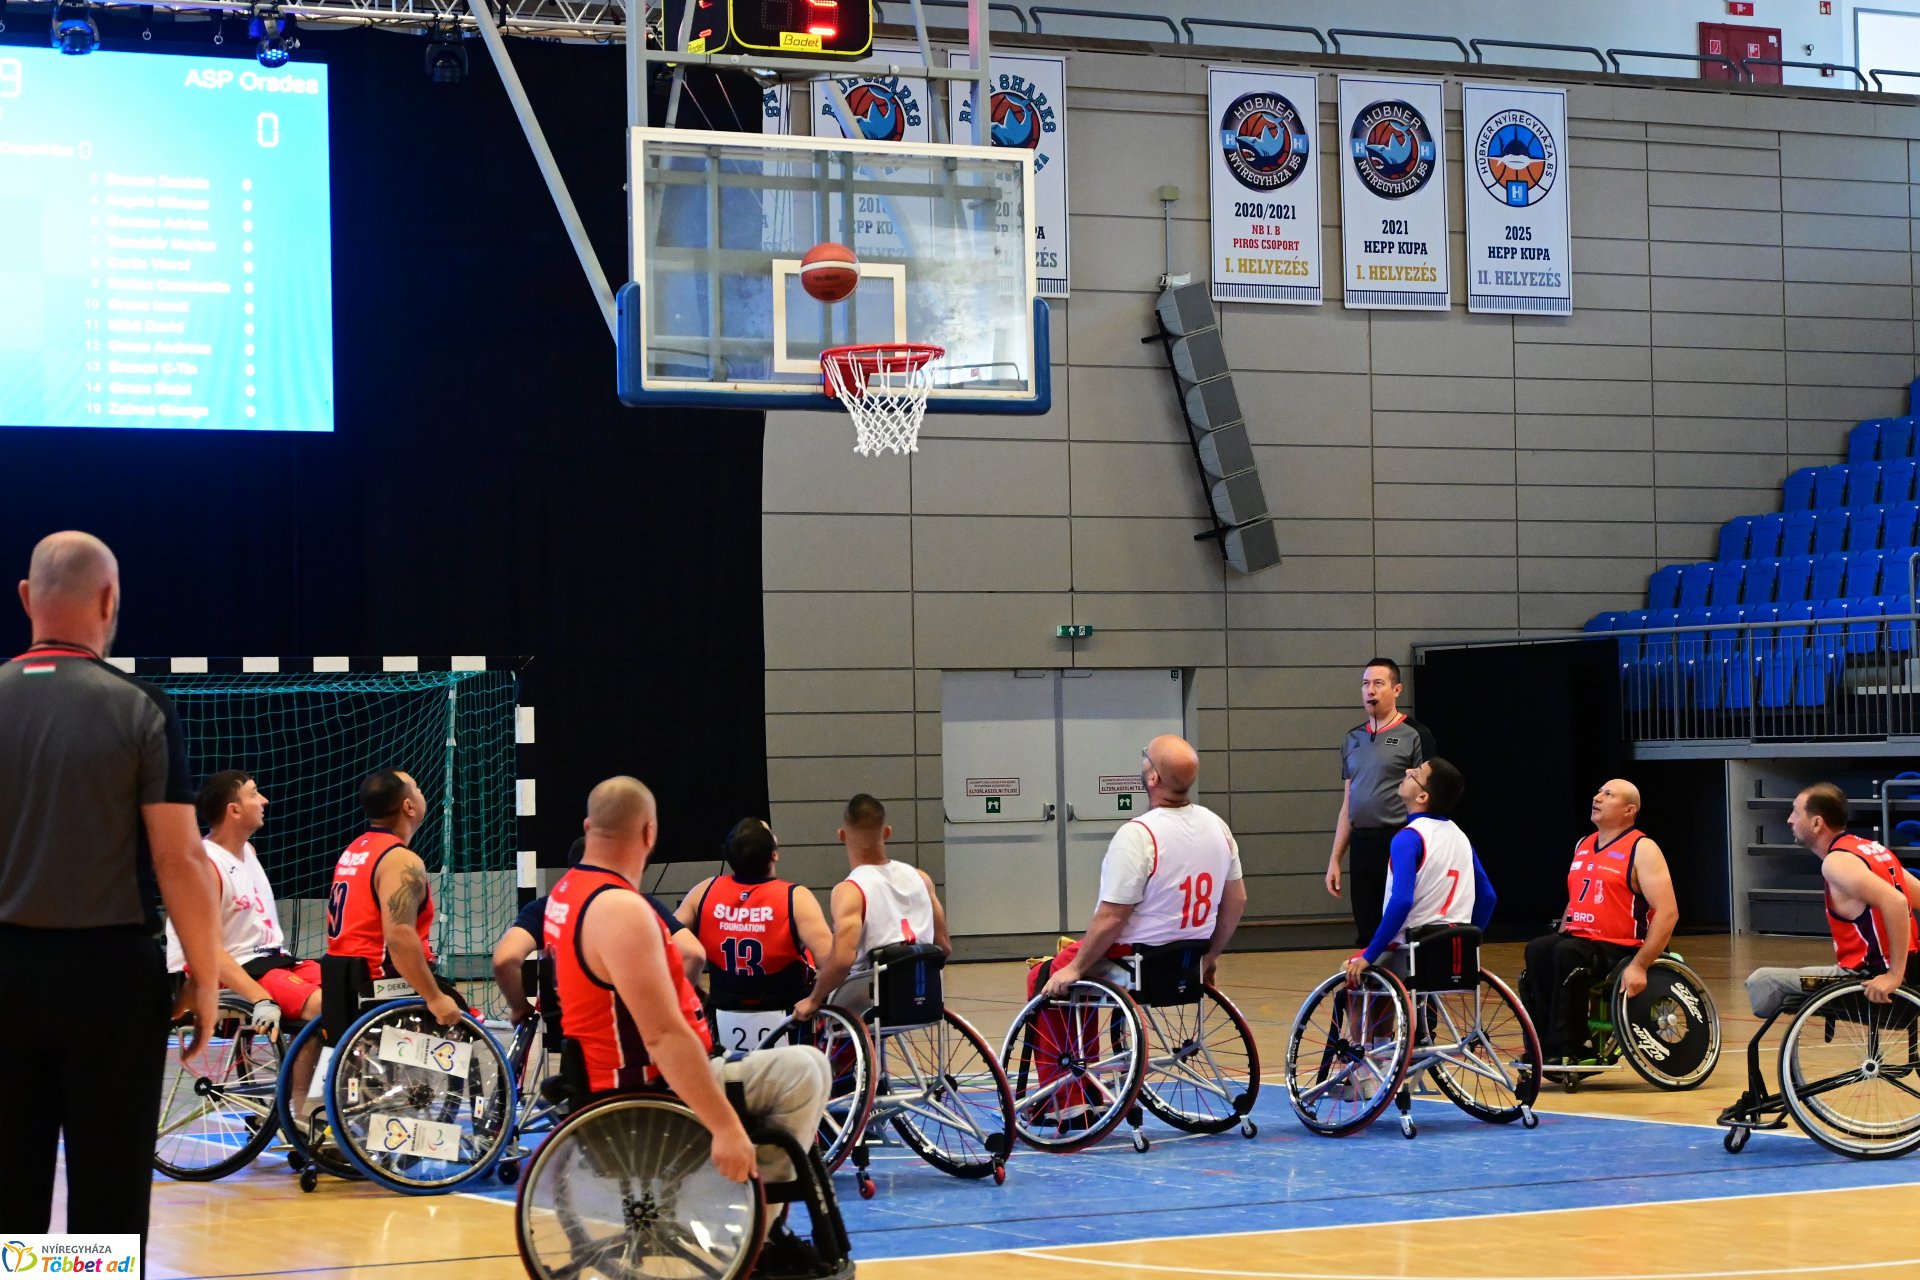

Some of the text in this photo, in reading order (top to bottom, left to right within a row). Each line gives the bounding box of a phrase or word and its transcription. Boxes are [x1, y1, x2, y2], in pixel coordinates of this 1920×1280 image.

[783, 35, 820, 48] Bodet
[185, 69, 235, 90] ASP
[999, 74, 1056, 133] SHARKS
[1363, 105, 1421, 130] HÜBNER
[257, 112, 280, 148] 0
[1225, 134, 1303, 149] H H
[1477, 112, 1554, 178] HÜBNER NYÍREGYHÁZA BS
[1355, 143, 1430, 157] H H
[1289, 154, 1301, 171] BS
[1417, 162, 1428, 177] BS
[1512, 185, 1523, 199] H
[859, 197, 888, 213] 201
[1234, 202, 1296, 220] 2020/2021
[1252, 225, 1281, 236] NB I. B
[1382, 219, 1408, 235] 2021
[1505, 225, 1532, 241] 2025
[1233, 238, 1299, 250] PIROS CSOPORT
[1364, 240, 1428, 255] HEPP KUPA
[1488, 246, 1550, 261] HEPP KUPA
[1225, 256, 1309, 276] I. HELYEZÉS
[1356, 261, 1437, 282] I. HELYEZÉS
[1478, 267, 1561, 287] II. HELYEZÉS
[86, 319, 99, 331] 11
[86, 382, 100, 393] 14
[1439, 869, 1459, 916] 7
[1578, 878, 1591, 903] 7
[1179, 872, 1213, 930] 18
[713, 903, 774, 923] SUPER
[1573, 911, 1595, 924] BRD
[719, 921, 766, 933] FOUNDATION
[720, 936, 766, 977] 13
